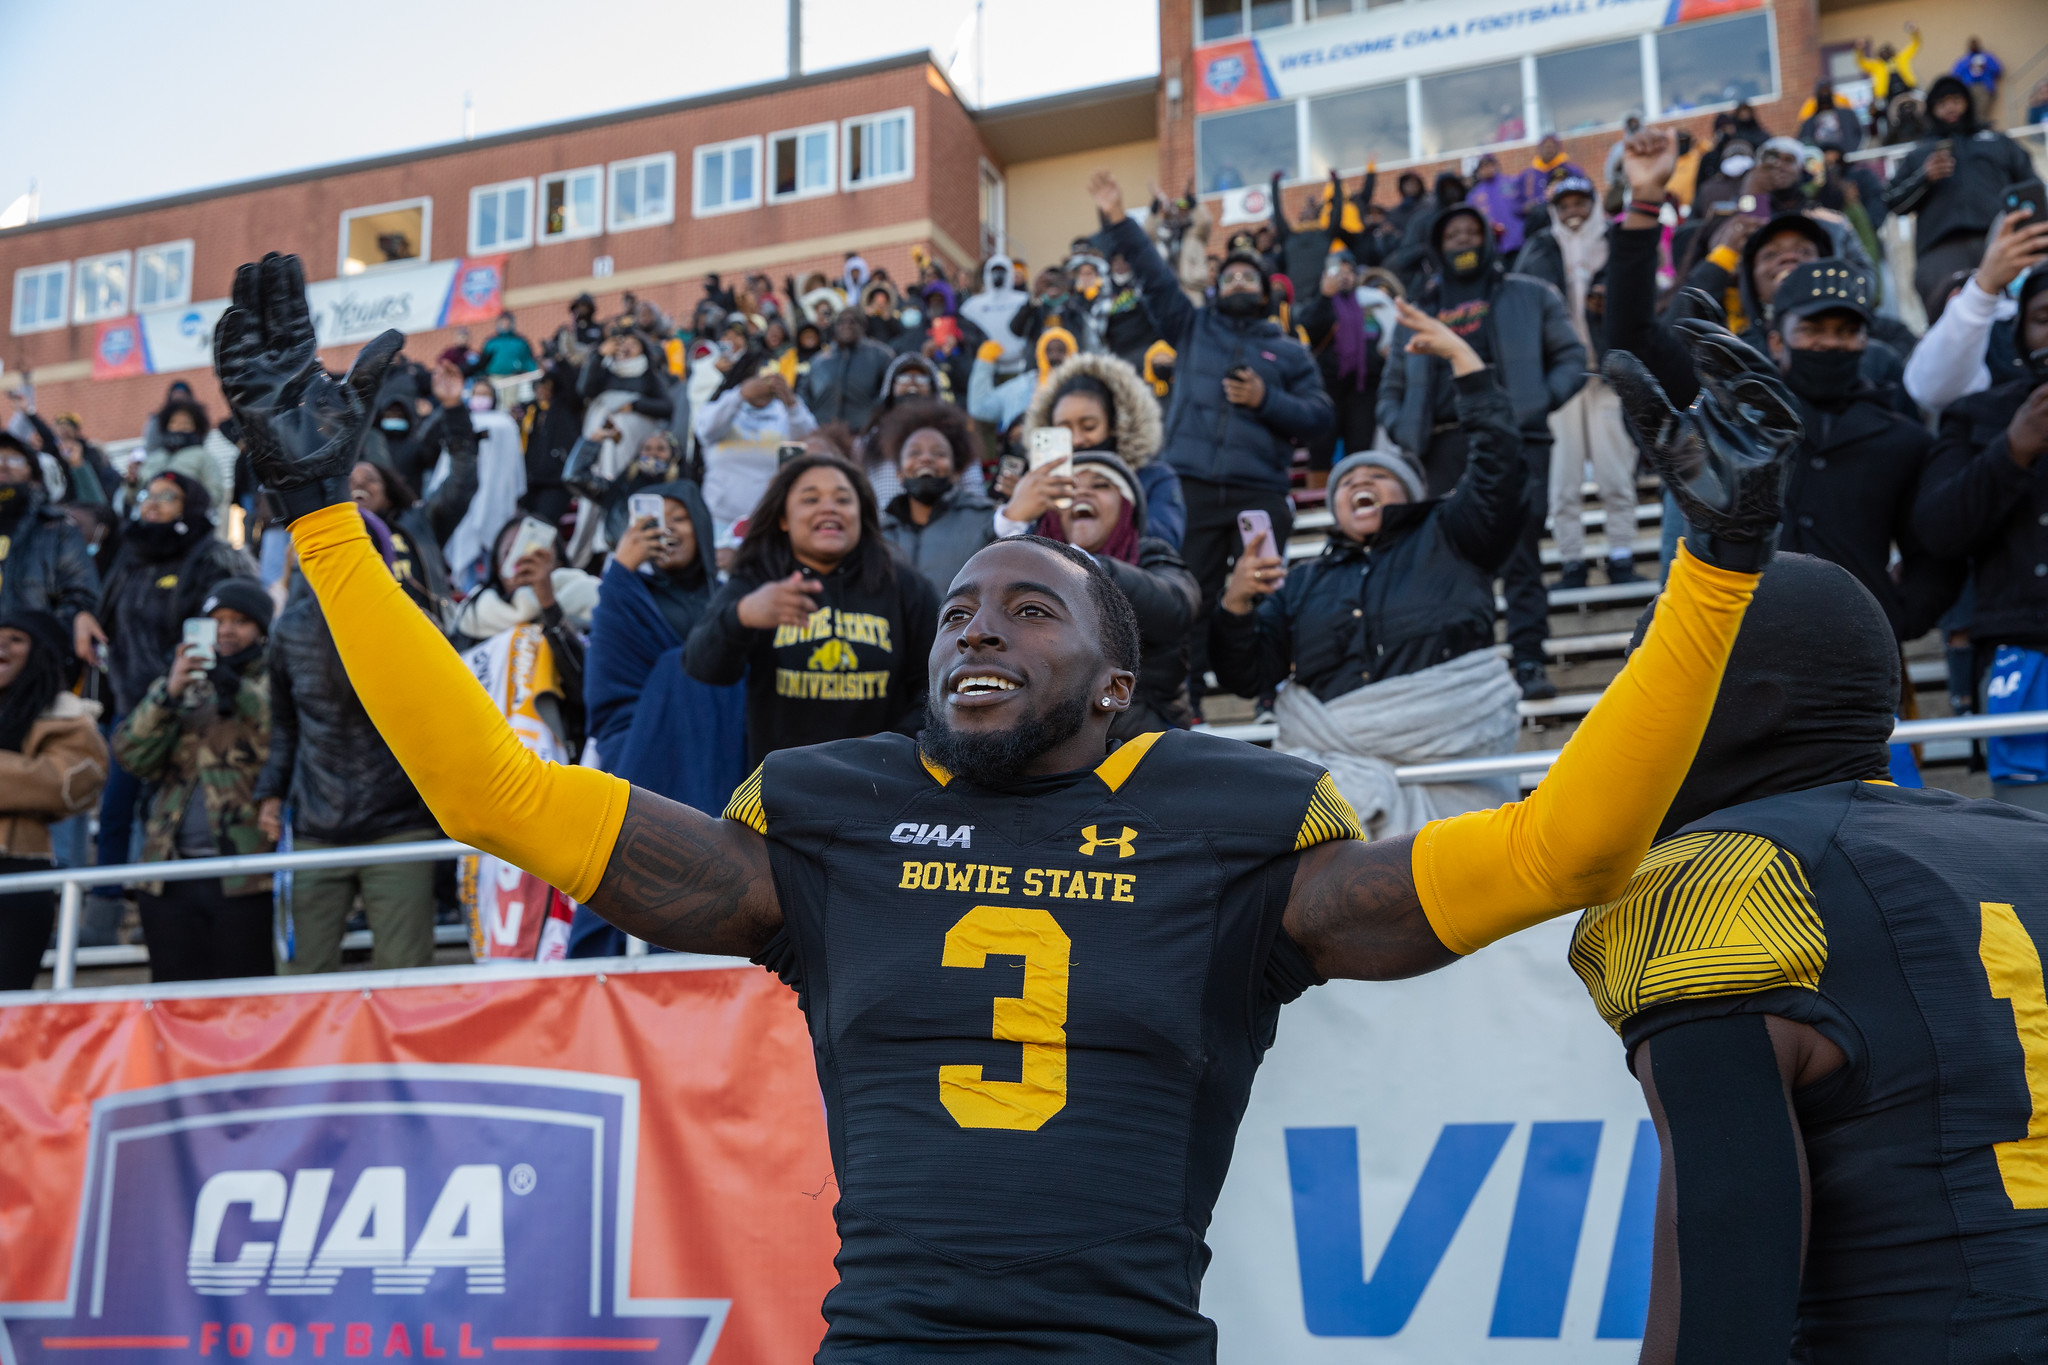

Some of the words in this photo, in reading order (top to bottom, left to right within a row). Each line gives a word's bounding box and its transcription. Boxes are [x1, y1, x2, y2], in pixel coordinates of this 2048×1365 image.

[775, 667, 890, 700] UNIVERSITY
[890, 822, 972, 849] CIAA
[898, 861, 1012, 894] BOWIE
[1022, 868, 1136, 902] STATE
[939, 905, 1071, 1131] 3
[187, 1163, 506, 1297] CIAA
[199, 1323, 484, 1358] FOOTBALL
